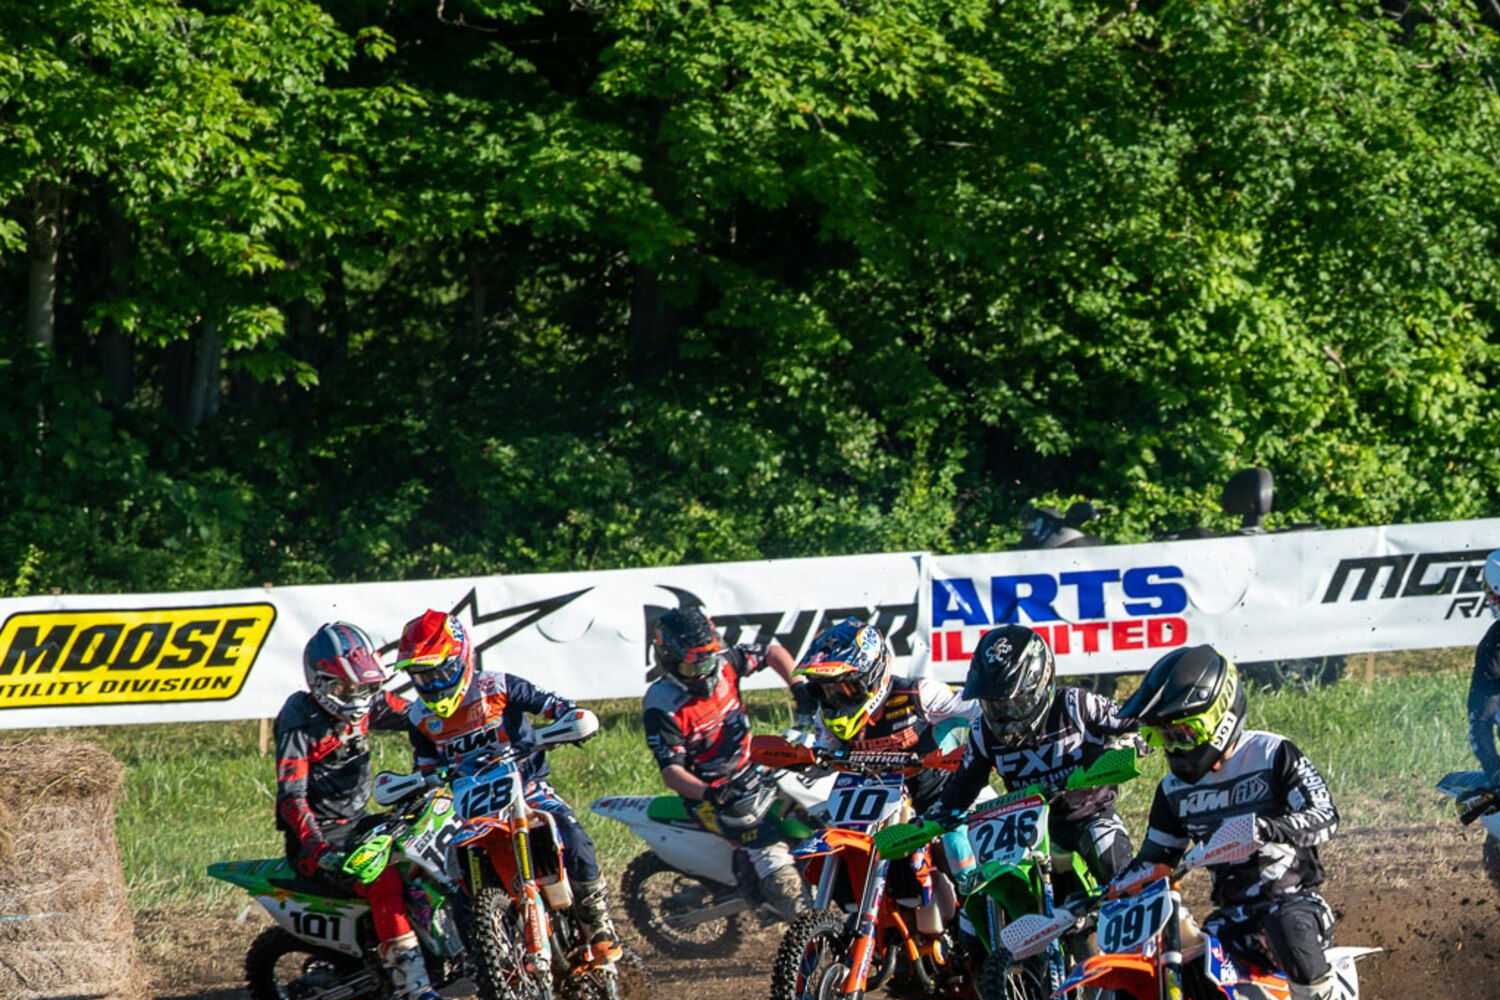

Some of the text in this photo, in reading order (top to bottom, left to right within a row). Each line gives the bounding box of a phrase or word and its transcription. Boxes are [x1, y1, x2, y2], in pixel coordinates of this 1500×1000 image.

[0, 617, 259, 676] MOOSE
[97, 676, 233, 694] DIVISION
[446, 726, 499, 757] KTM
[1212, 717, 1235, 747] 991
[995, 731, 1084, 778] FXR
[461, 776, 514, 819] 128
[834, 788, 890, 822] 10
[1179, 789, 1231, 818] KTM
[975, 810, 1039, 864] 246
[289, 911, 341, 941] 101
[1103, 896, 1165, 954] 991
